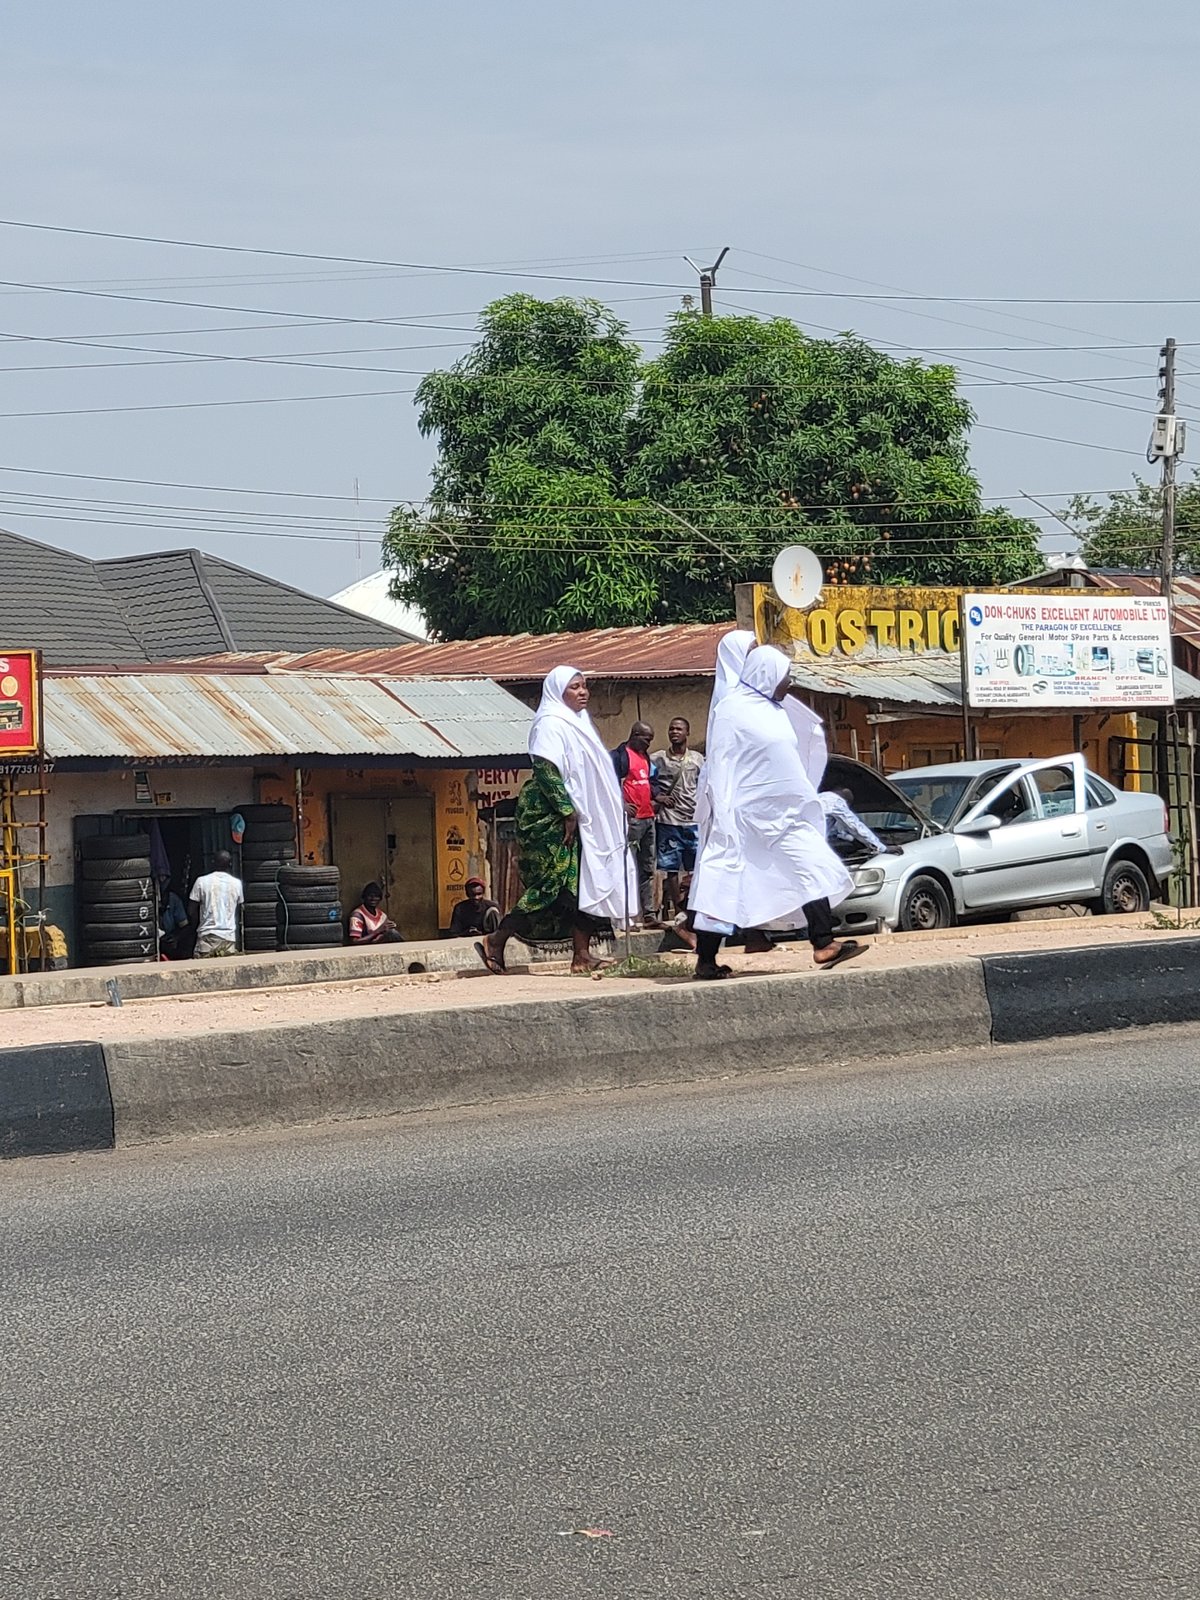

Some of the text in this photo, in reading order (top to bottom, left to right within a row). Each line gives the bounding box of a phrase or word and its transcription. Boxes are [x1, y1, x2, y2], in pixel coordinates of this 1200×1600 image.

[984, 605, 1036, 620] DON-CHUKS
[1041, 607, 1090, 621] EXCELLENT
[1092, 608, 1148, 621] AUTOMOBILE
[1151, 608, 1167, 621] LTD
[1021, 623, 1122, 631] THE PARAGON OF EXCELLENCE
[994, 633, 1016, 642] Quality
[1018, 633, 1045, 641] General
[1048, 633, 1068, 641] Motor
